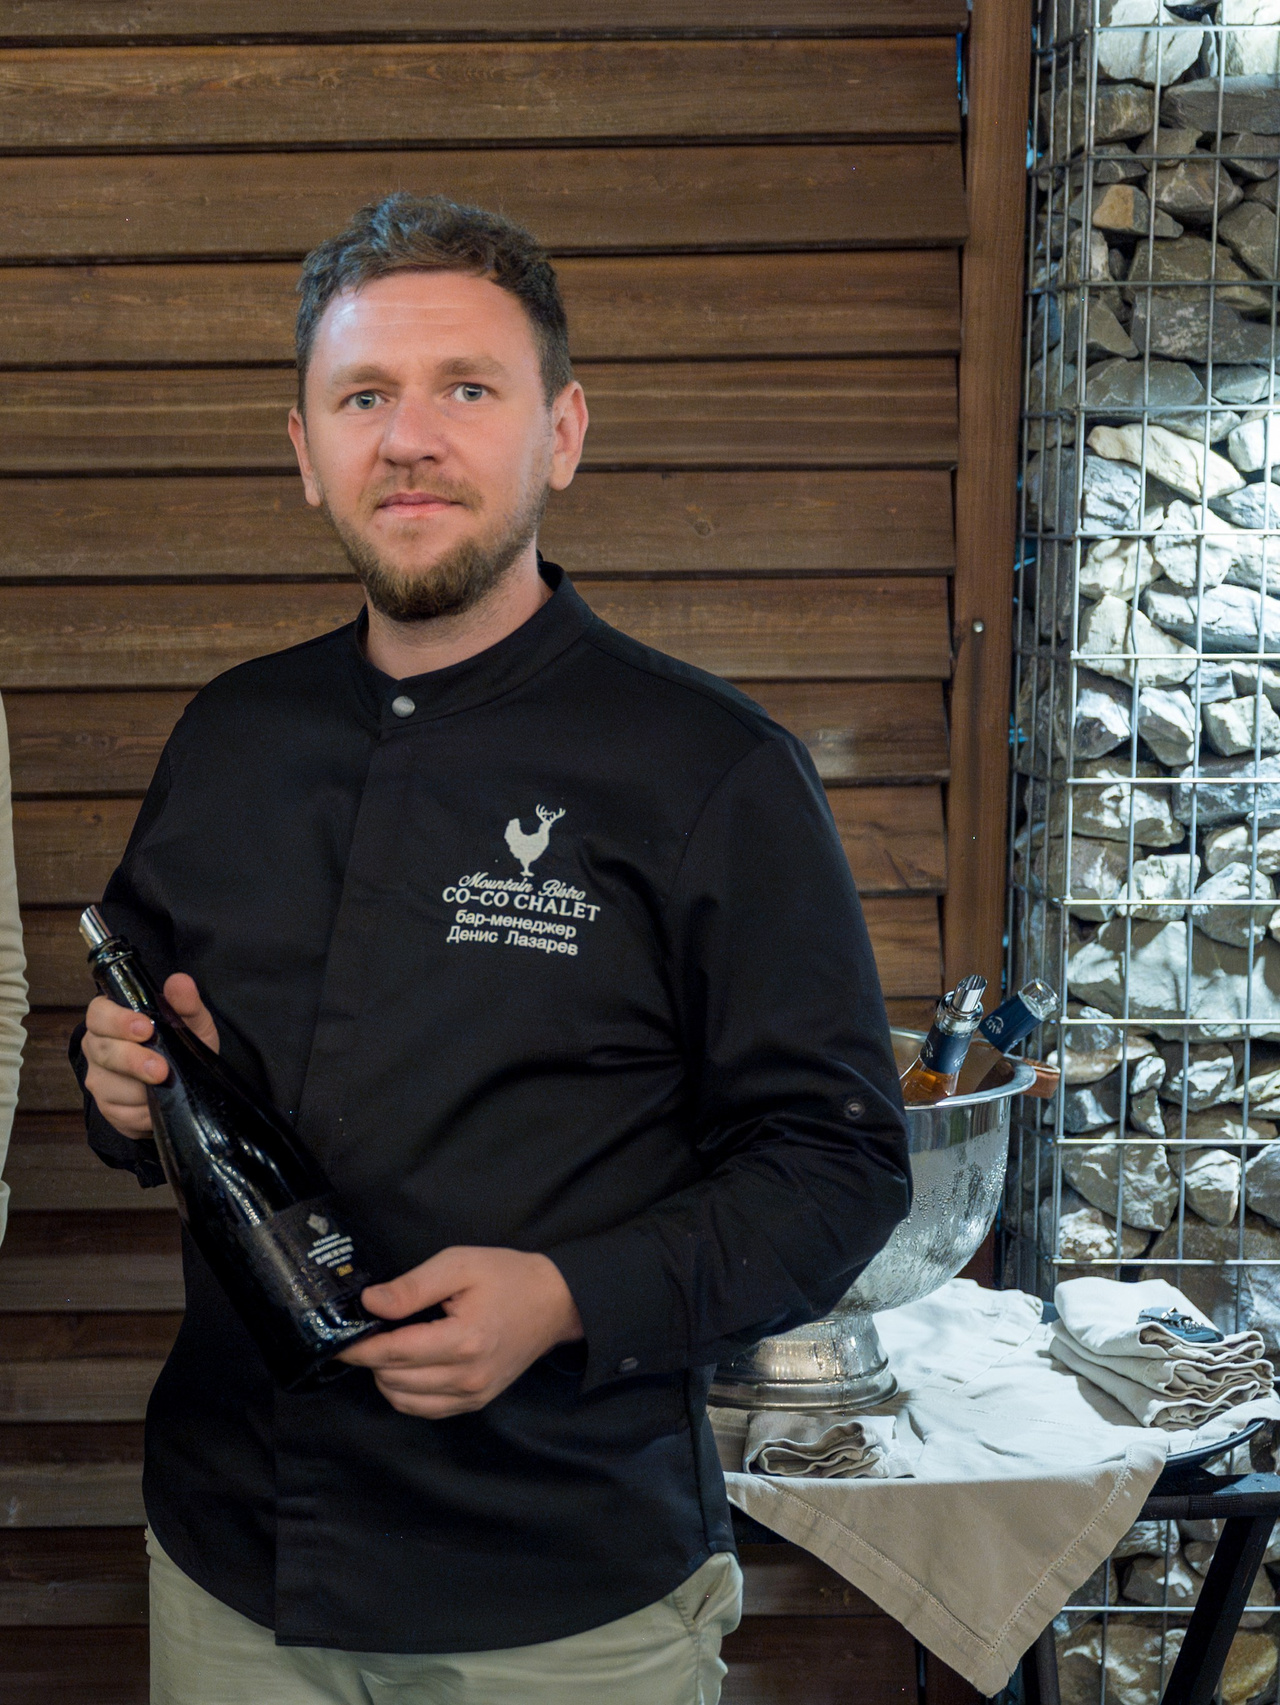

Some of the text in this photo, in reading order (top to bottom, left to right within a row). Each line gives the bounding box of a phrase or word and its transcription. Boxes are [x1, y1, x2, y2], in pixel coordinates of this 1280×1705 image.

[459, 871, 586, 901] Mountain Bistro
[443, 886, 601, 922] CO-CO CHALET
[455, 909, 577, 940] бар-менеджер
[446, 925, 578, 956] Денис Лазарев
